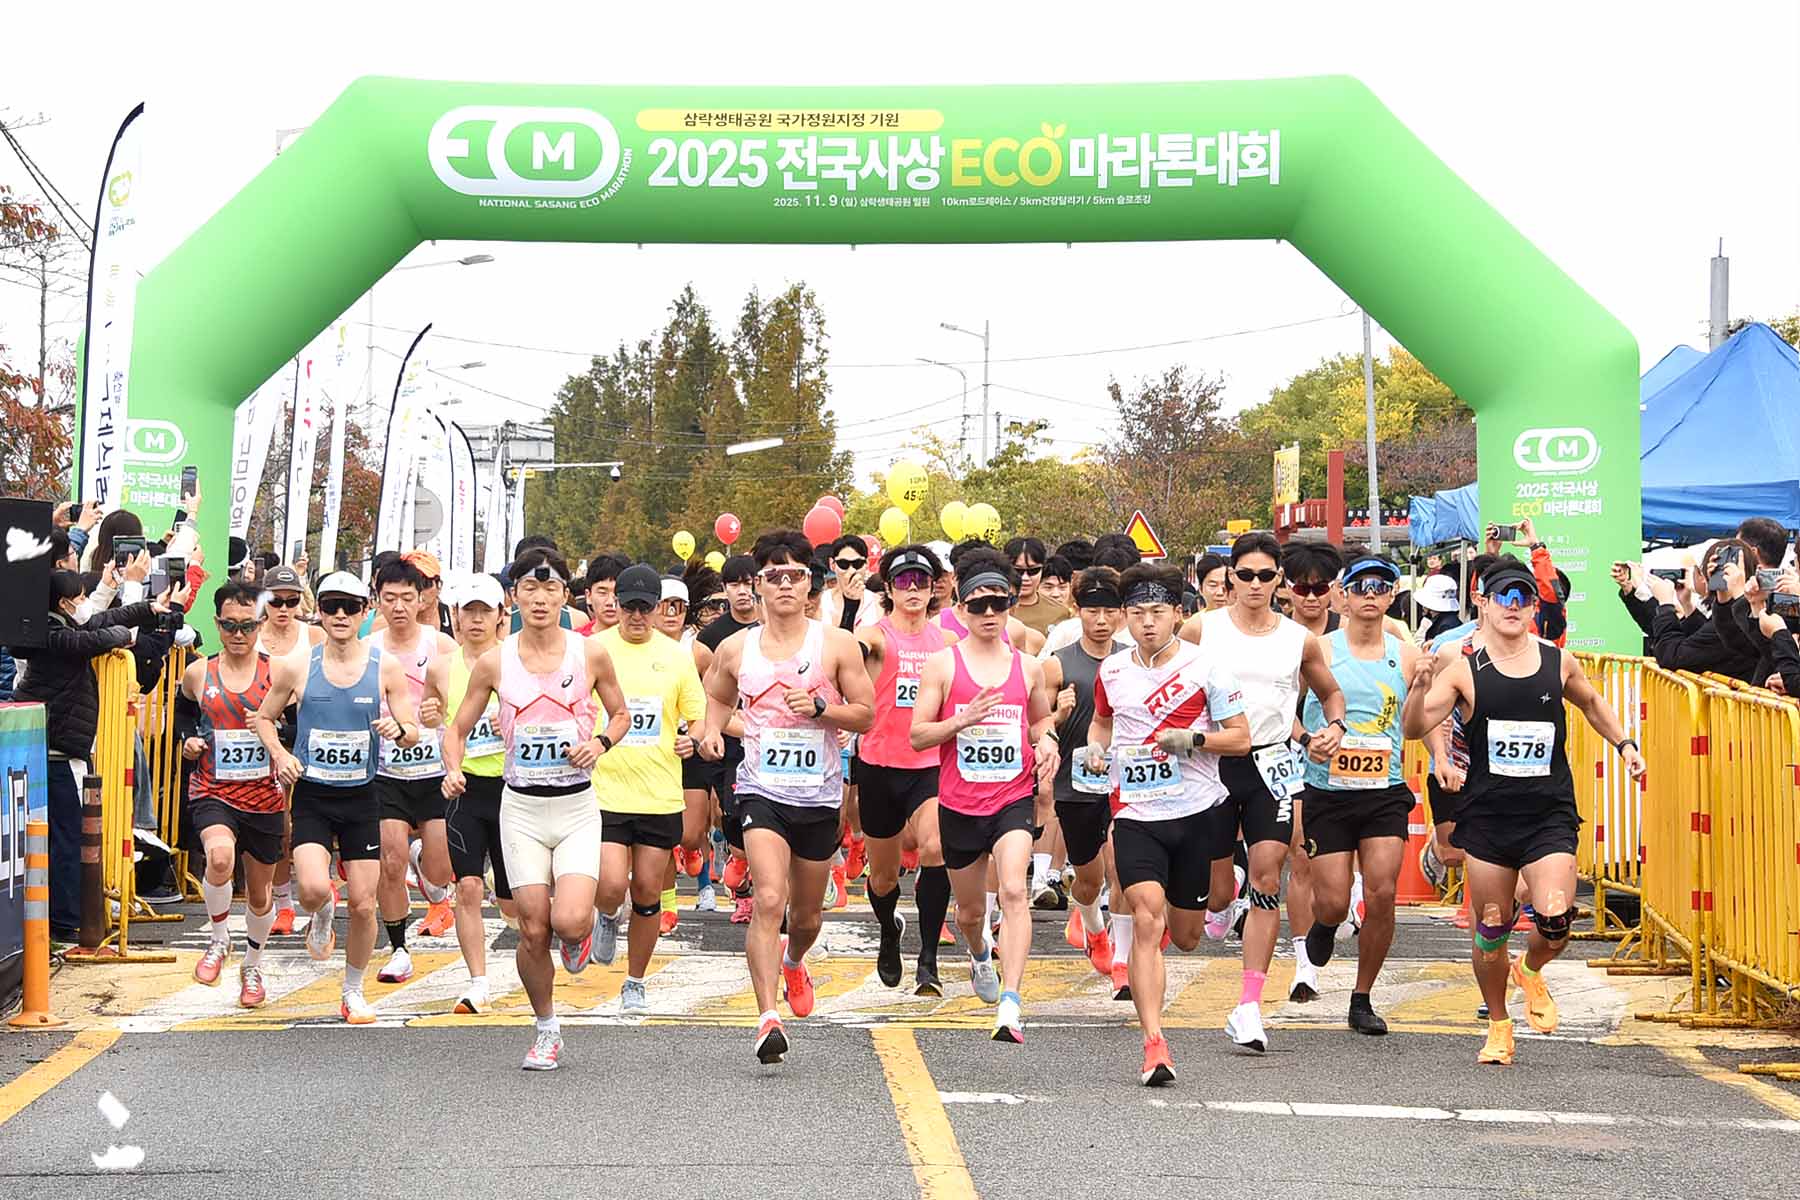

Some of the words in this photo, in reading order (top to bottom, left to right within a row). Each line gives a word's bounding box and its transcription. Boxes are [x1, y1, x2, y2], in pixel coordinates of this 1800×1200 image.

[684, 112, 772, 128] 삼락생태공원
[776, 112, 865, 128] 국가정원지정
[870, 112, 899, 128] 기원
[647, 138, 769, 188] 2025
[776, 135, 946, 191] 전국사상
[950, 135, 1063, 188] ECO
[1068, 129, 1281, 189] 마라톤대회
[478, 199, 531, 208] NATIONAL
[534, 200, 577, 209] SASANG
[579, 197, 600, 209] ECO
[600, 147, 633, 202] MARATHON
[1516, 481, 1549, 498] 2025
[1550, 479, 1599, 498] 전국사상
[1512, 499, 1542, 517] ECO
[897, 685, 918, 701] 26
[633, 713, 656, 730] 97
[221, 746, 266, 763] 2373
[315, 747, 362, 765] 2654
[391, 745, 434, 763] 2692
[766, 748, 817, 768] 2710
[964, 745, 1015, 764] 2690
[1495, 740, 1546, 759] 2578
[1124, 762, 1173, 783] 2378
[1267, 759, 1296, 784] 267
[1337, 755, 1384, 772] 9023
